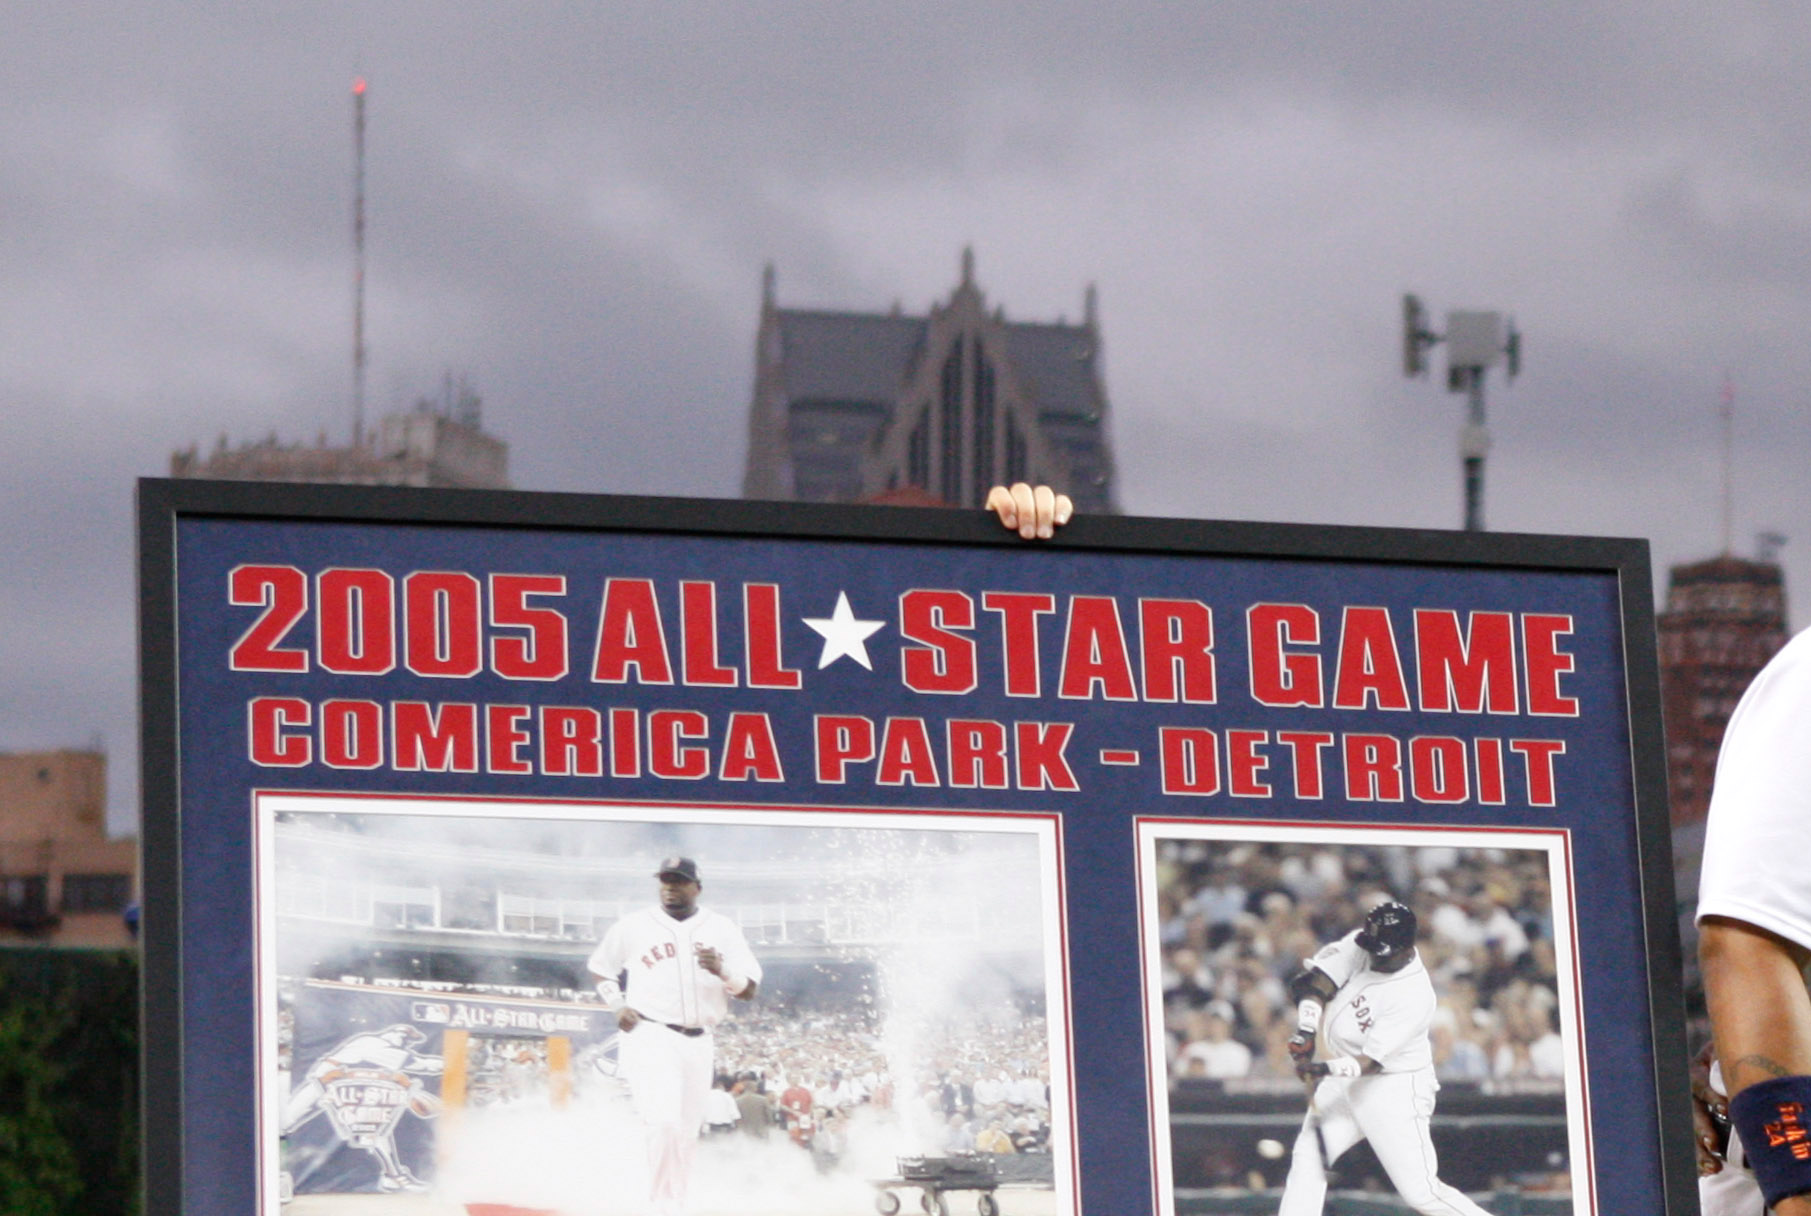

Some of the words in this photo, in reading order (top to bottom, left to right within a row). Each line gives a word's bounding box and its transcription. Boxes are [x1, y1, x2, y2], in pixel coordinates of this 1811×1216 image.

[228, 564, 569, 682] 2005
[590, 577, 803, 690] ALL
[899, 588, 1218, 705] STAR
[1245, 602, 1580, 717] GAME
[247, 697, 786, 783] COMERICA
[813, 714, 1081, 793] PARK
[1158, 726, 1566, 807] DETROIT
[641, 942, 676, 970] RED
[1351, 995, 1374, 1033] SOX
